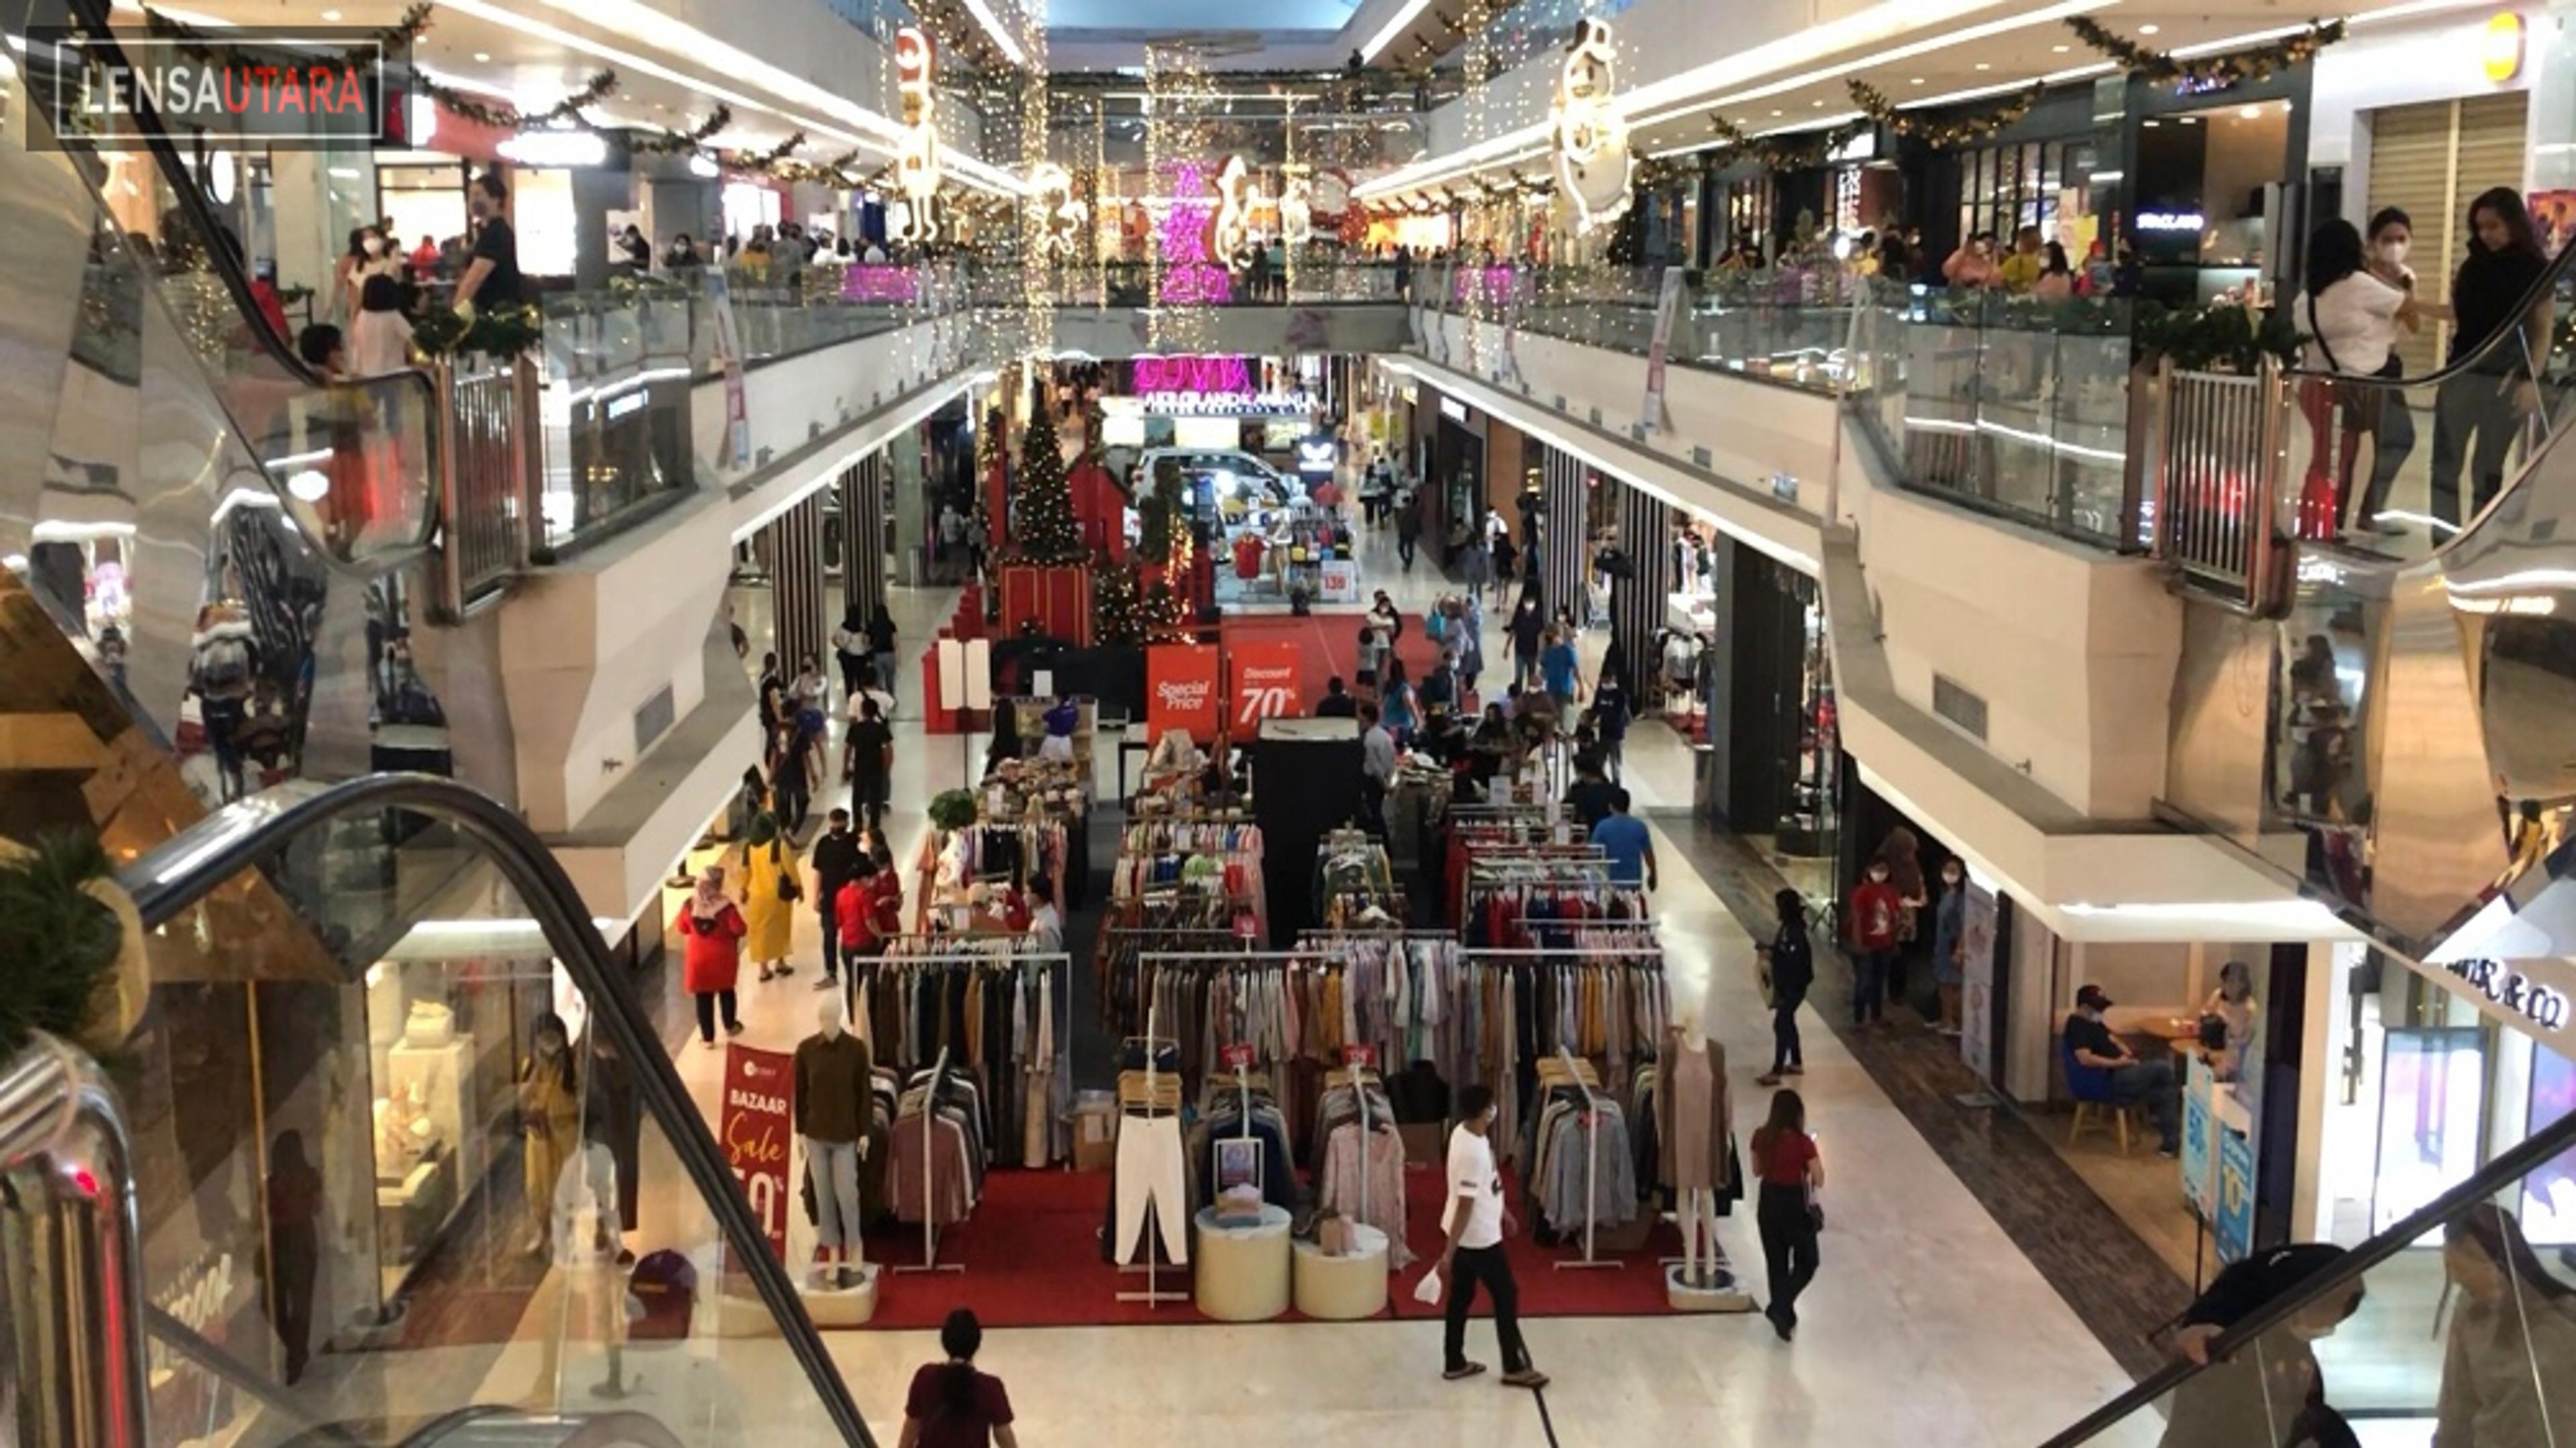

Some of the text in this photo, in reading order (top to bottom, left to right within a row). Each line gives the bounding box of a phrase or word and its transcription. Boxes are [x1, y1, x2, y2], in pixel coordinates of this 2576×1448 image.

[1243, 668, 1292, 679] Discount
[1157, 680, 1210, 699] Special
[1166, 696, 1203, 710] Price
[729, 1088, 786, 1114] BAZAAR
[726, 1110, 784, 1163] Sale
